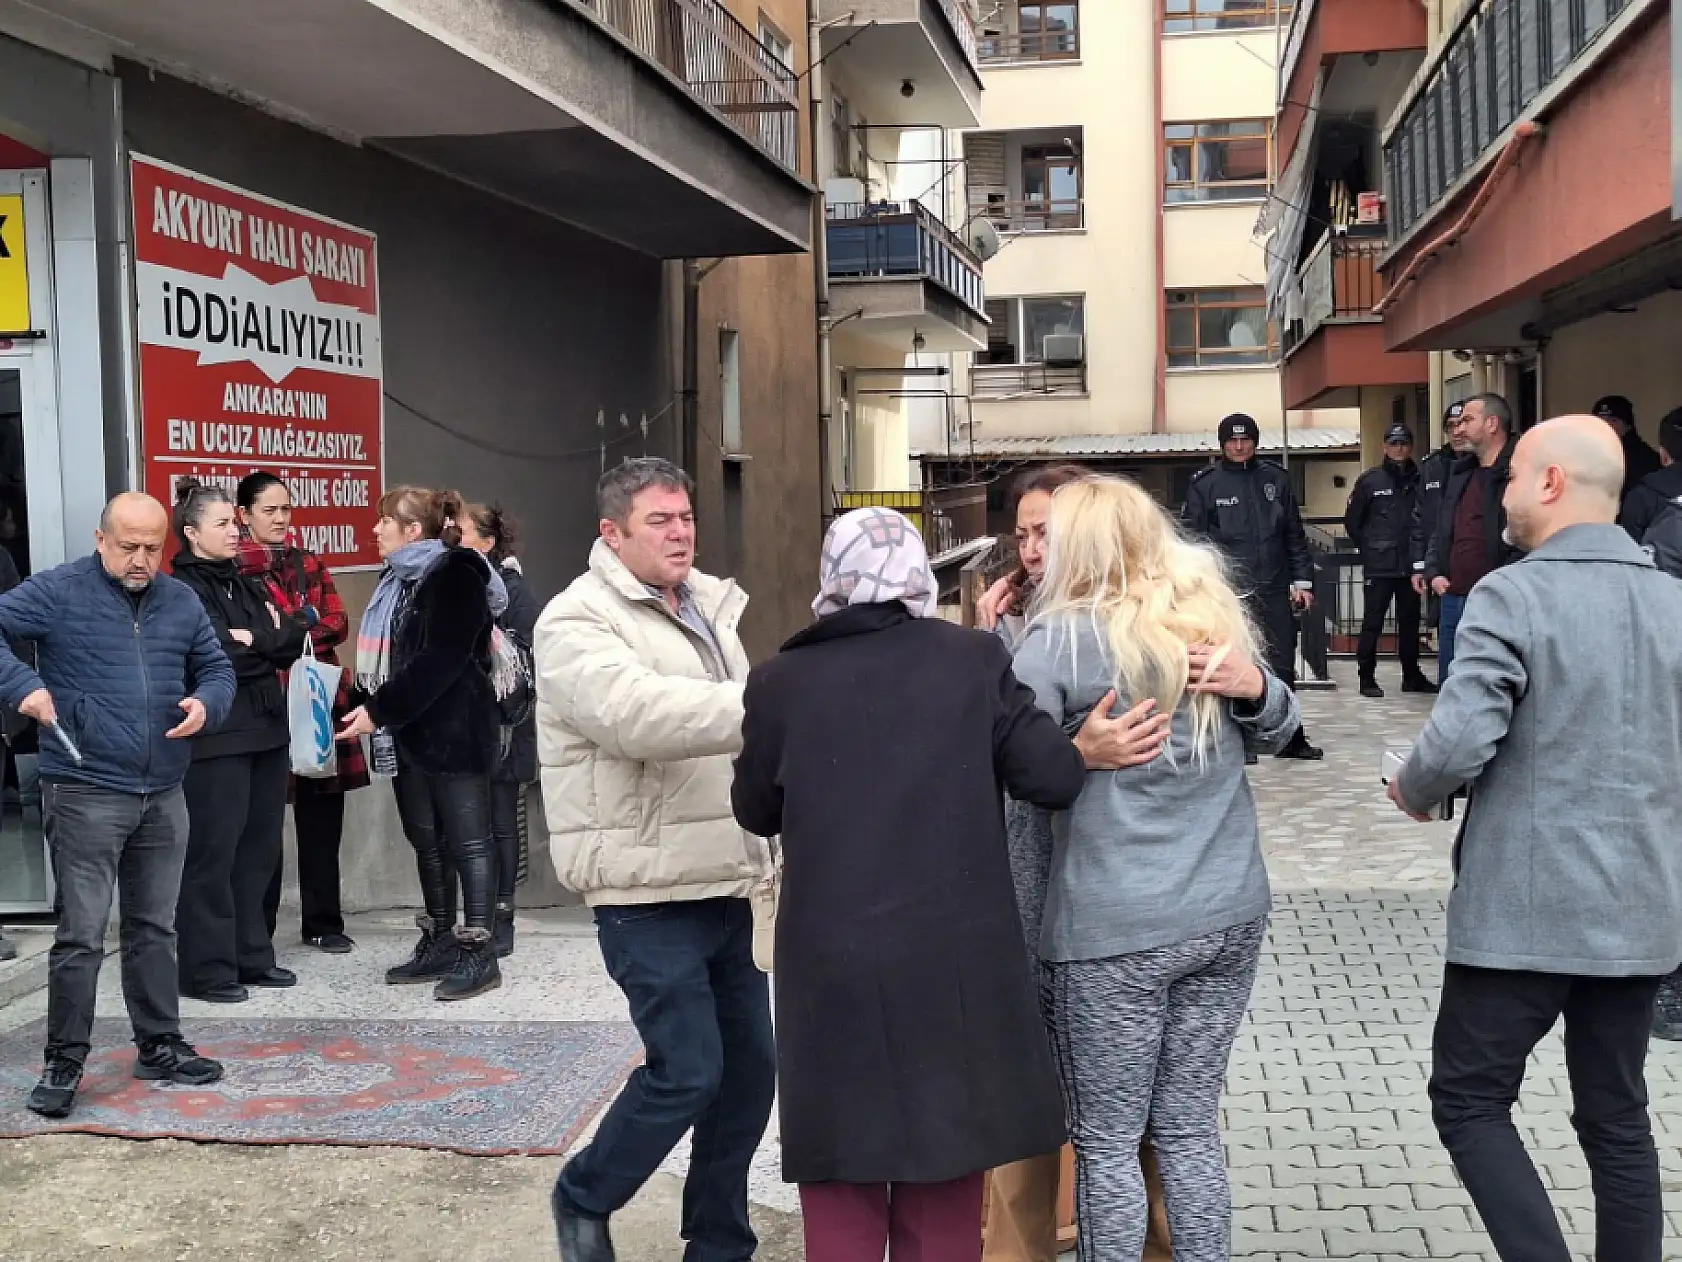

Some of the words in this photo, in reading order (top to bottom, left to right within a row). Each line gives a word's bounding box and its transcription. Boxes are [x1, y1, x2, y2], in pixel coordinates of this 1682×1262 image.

[152, 185, 243, 255] AKYURT
[248, 214, 297, 270] HALI
[301, 230, 366, 288] SARAYI
[222, 382, 327, 420] ANKARA'NIN
[167, 418, 196, 451] EN
[201, 422, 253, 454] UCUZ
[257, 422, 367, 461] MAĞAZASIYIZ.
[332, 472, 369, 507] GÖRE
[301, 524, 360, 555] YAPILIR.
